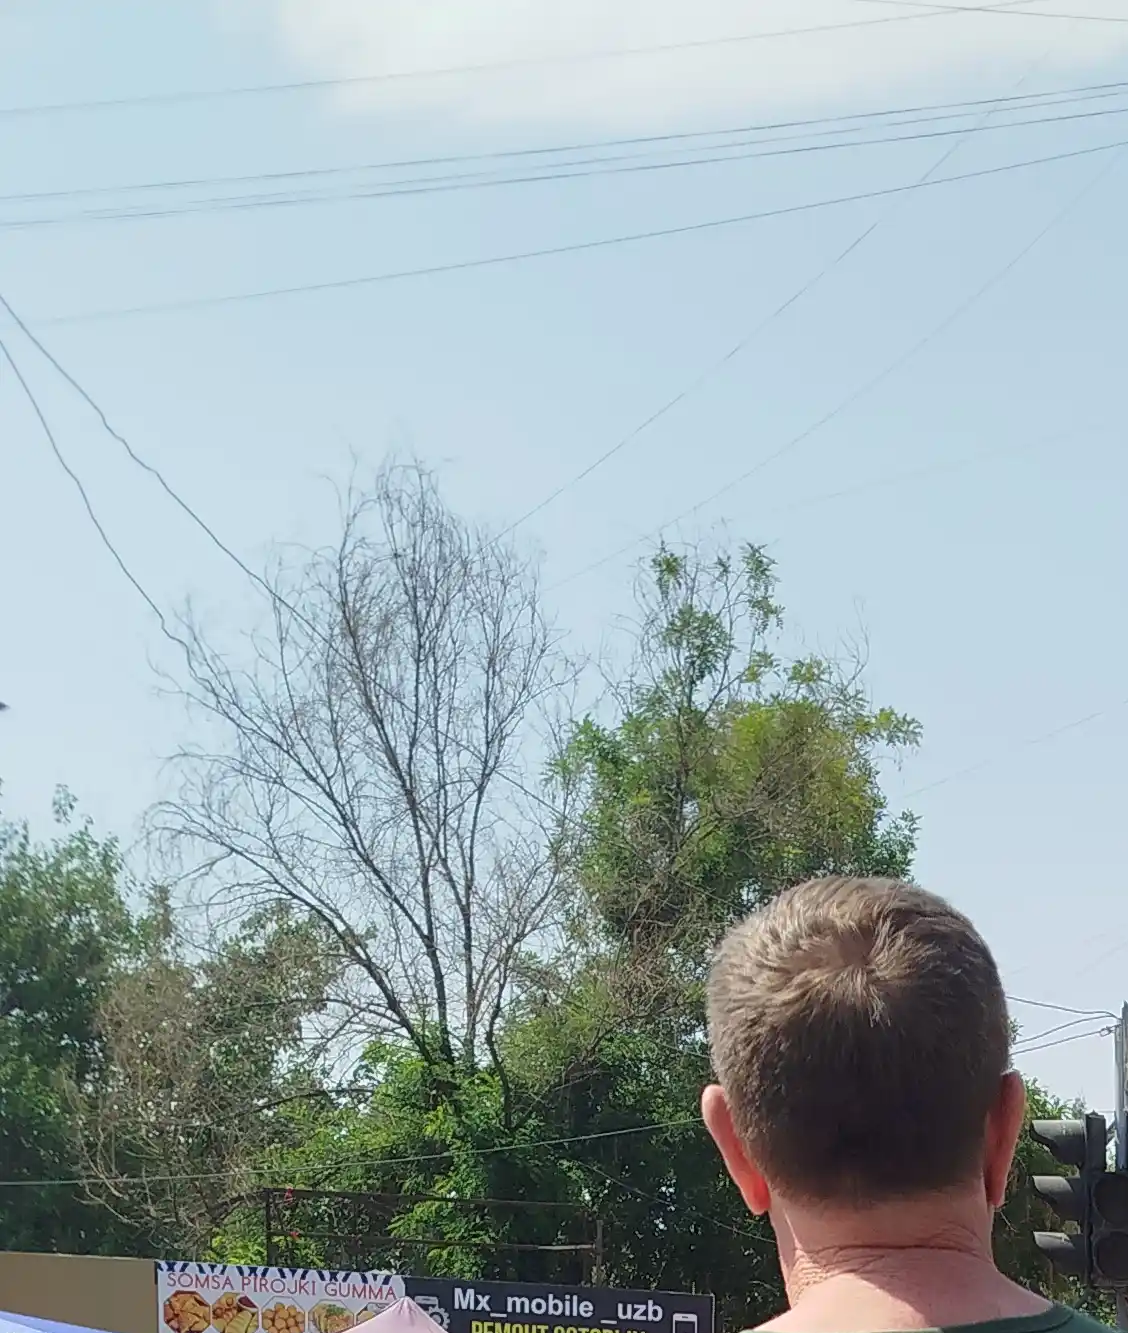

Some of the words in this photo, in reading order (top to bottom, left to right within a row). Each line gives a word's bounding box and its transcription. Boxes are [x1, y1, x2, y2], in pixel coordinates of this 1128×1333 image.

[167, 1272, 235, 1291] SOMSA
[241, 1276, 316, 1297] PIROJKI
[324, 1280, 398, 1300] GUMMA
[454, 1287, 595, 1318] Mx_mobile
